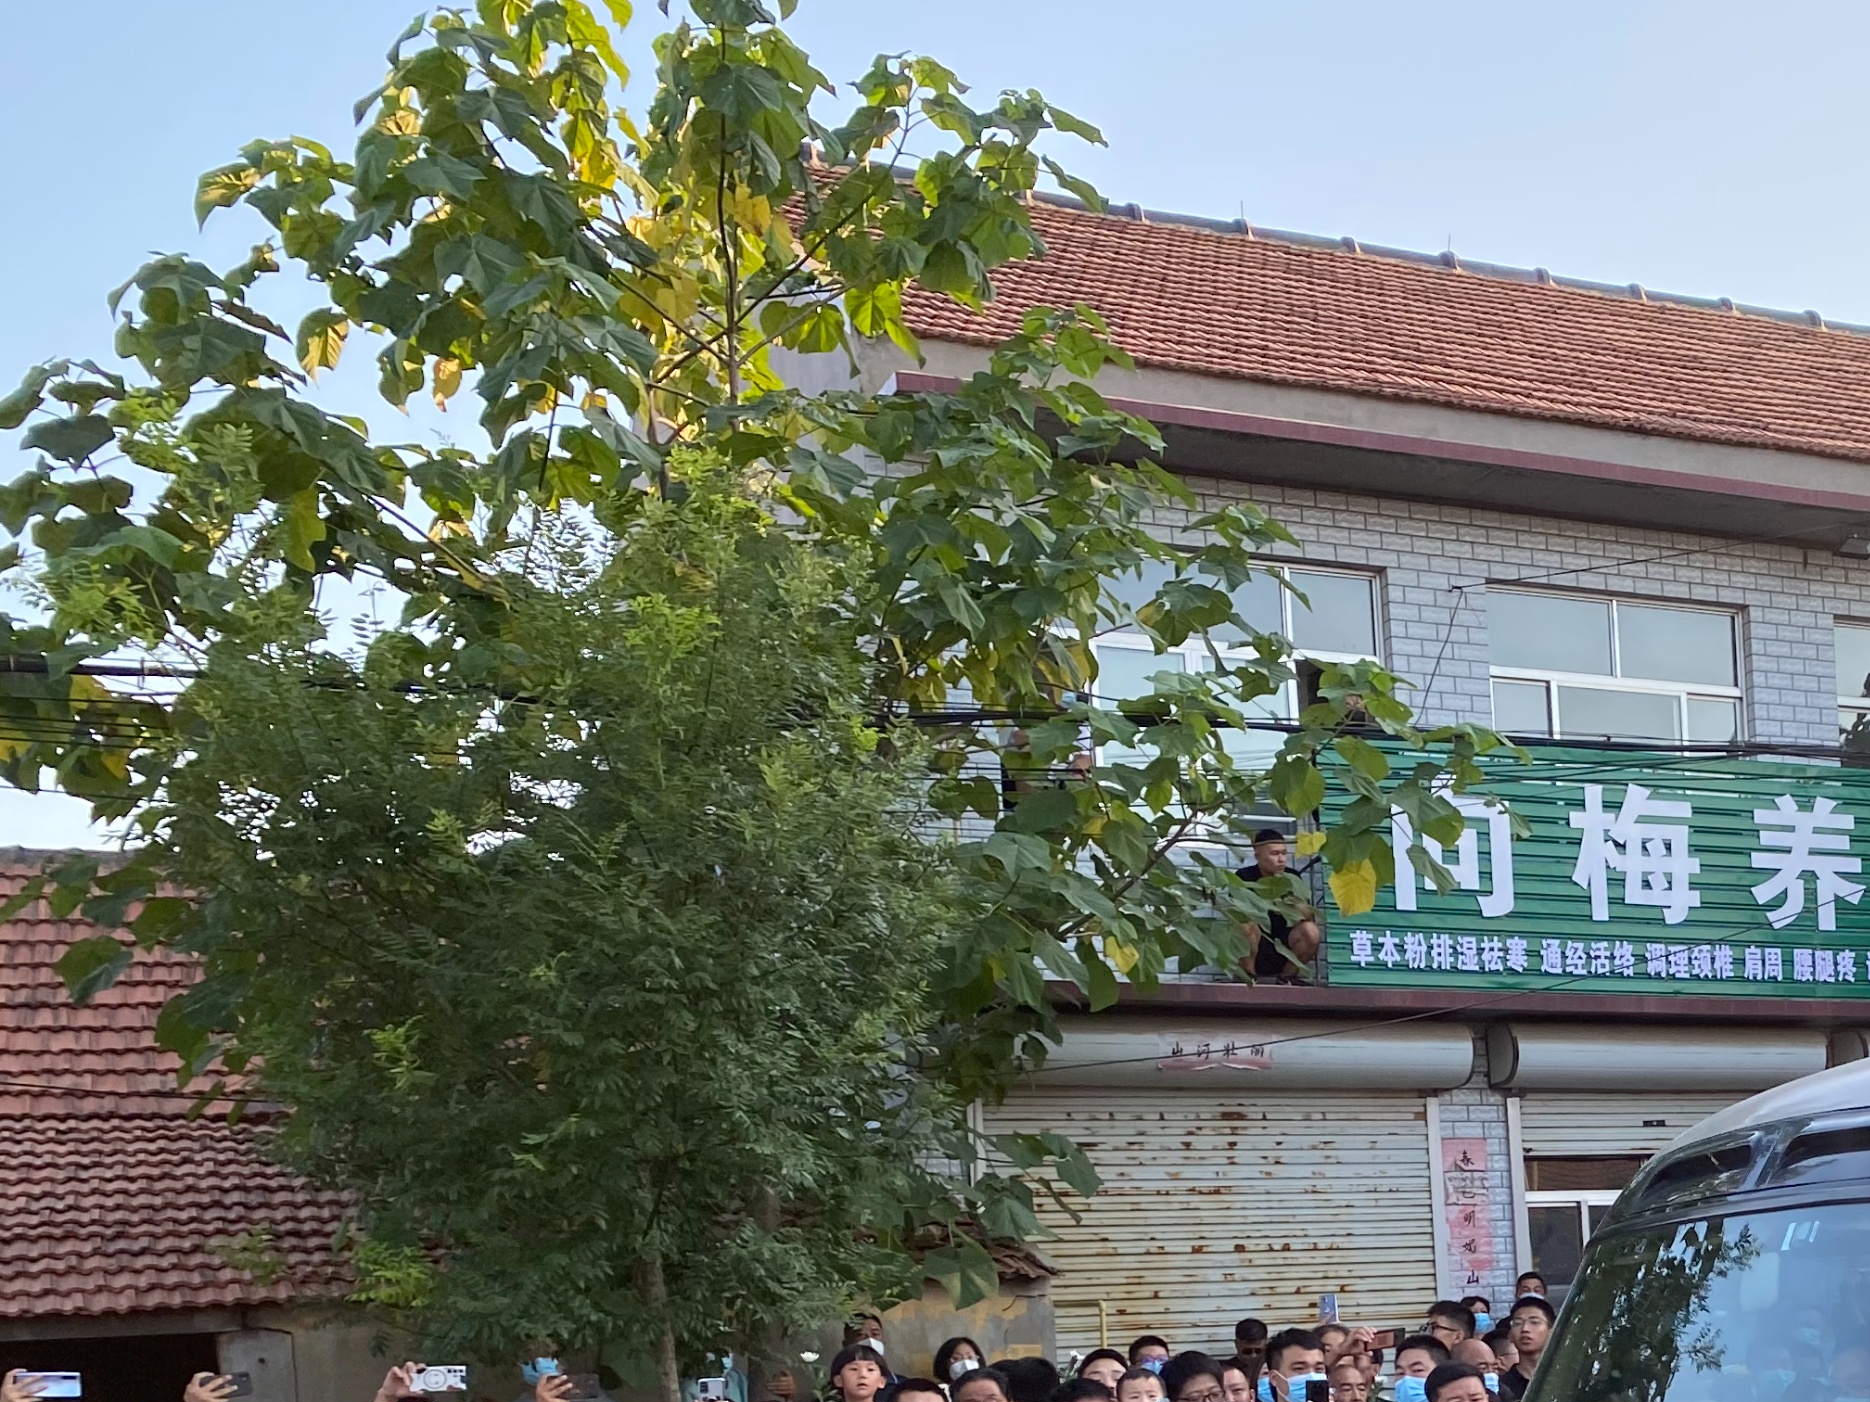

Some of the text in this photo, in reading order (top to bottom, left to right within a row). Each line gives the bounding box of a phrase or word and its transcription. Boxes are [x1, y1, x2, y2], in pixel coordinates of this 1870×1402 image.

[1350, 930, 1528, 973] 草本粉排湿祛寒
[1541, 939, 1635, 976] 通经活络
[1645, 942, 1735, 980] 调理颈椎
[1744, 946, 1783, 981] 肩周
[1793, 948, 1857, 983] 腰腿疼
